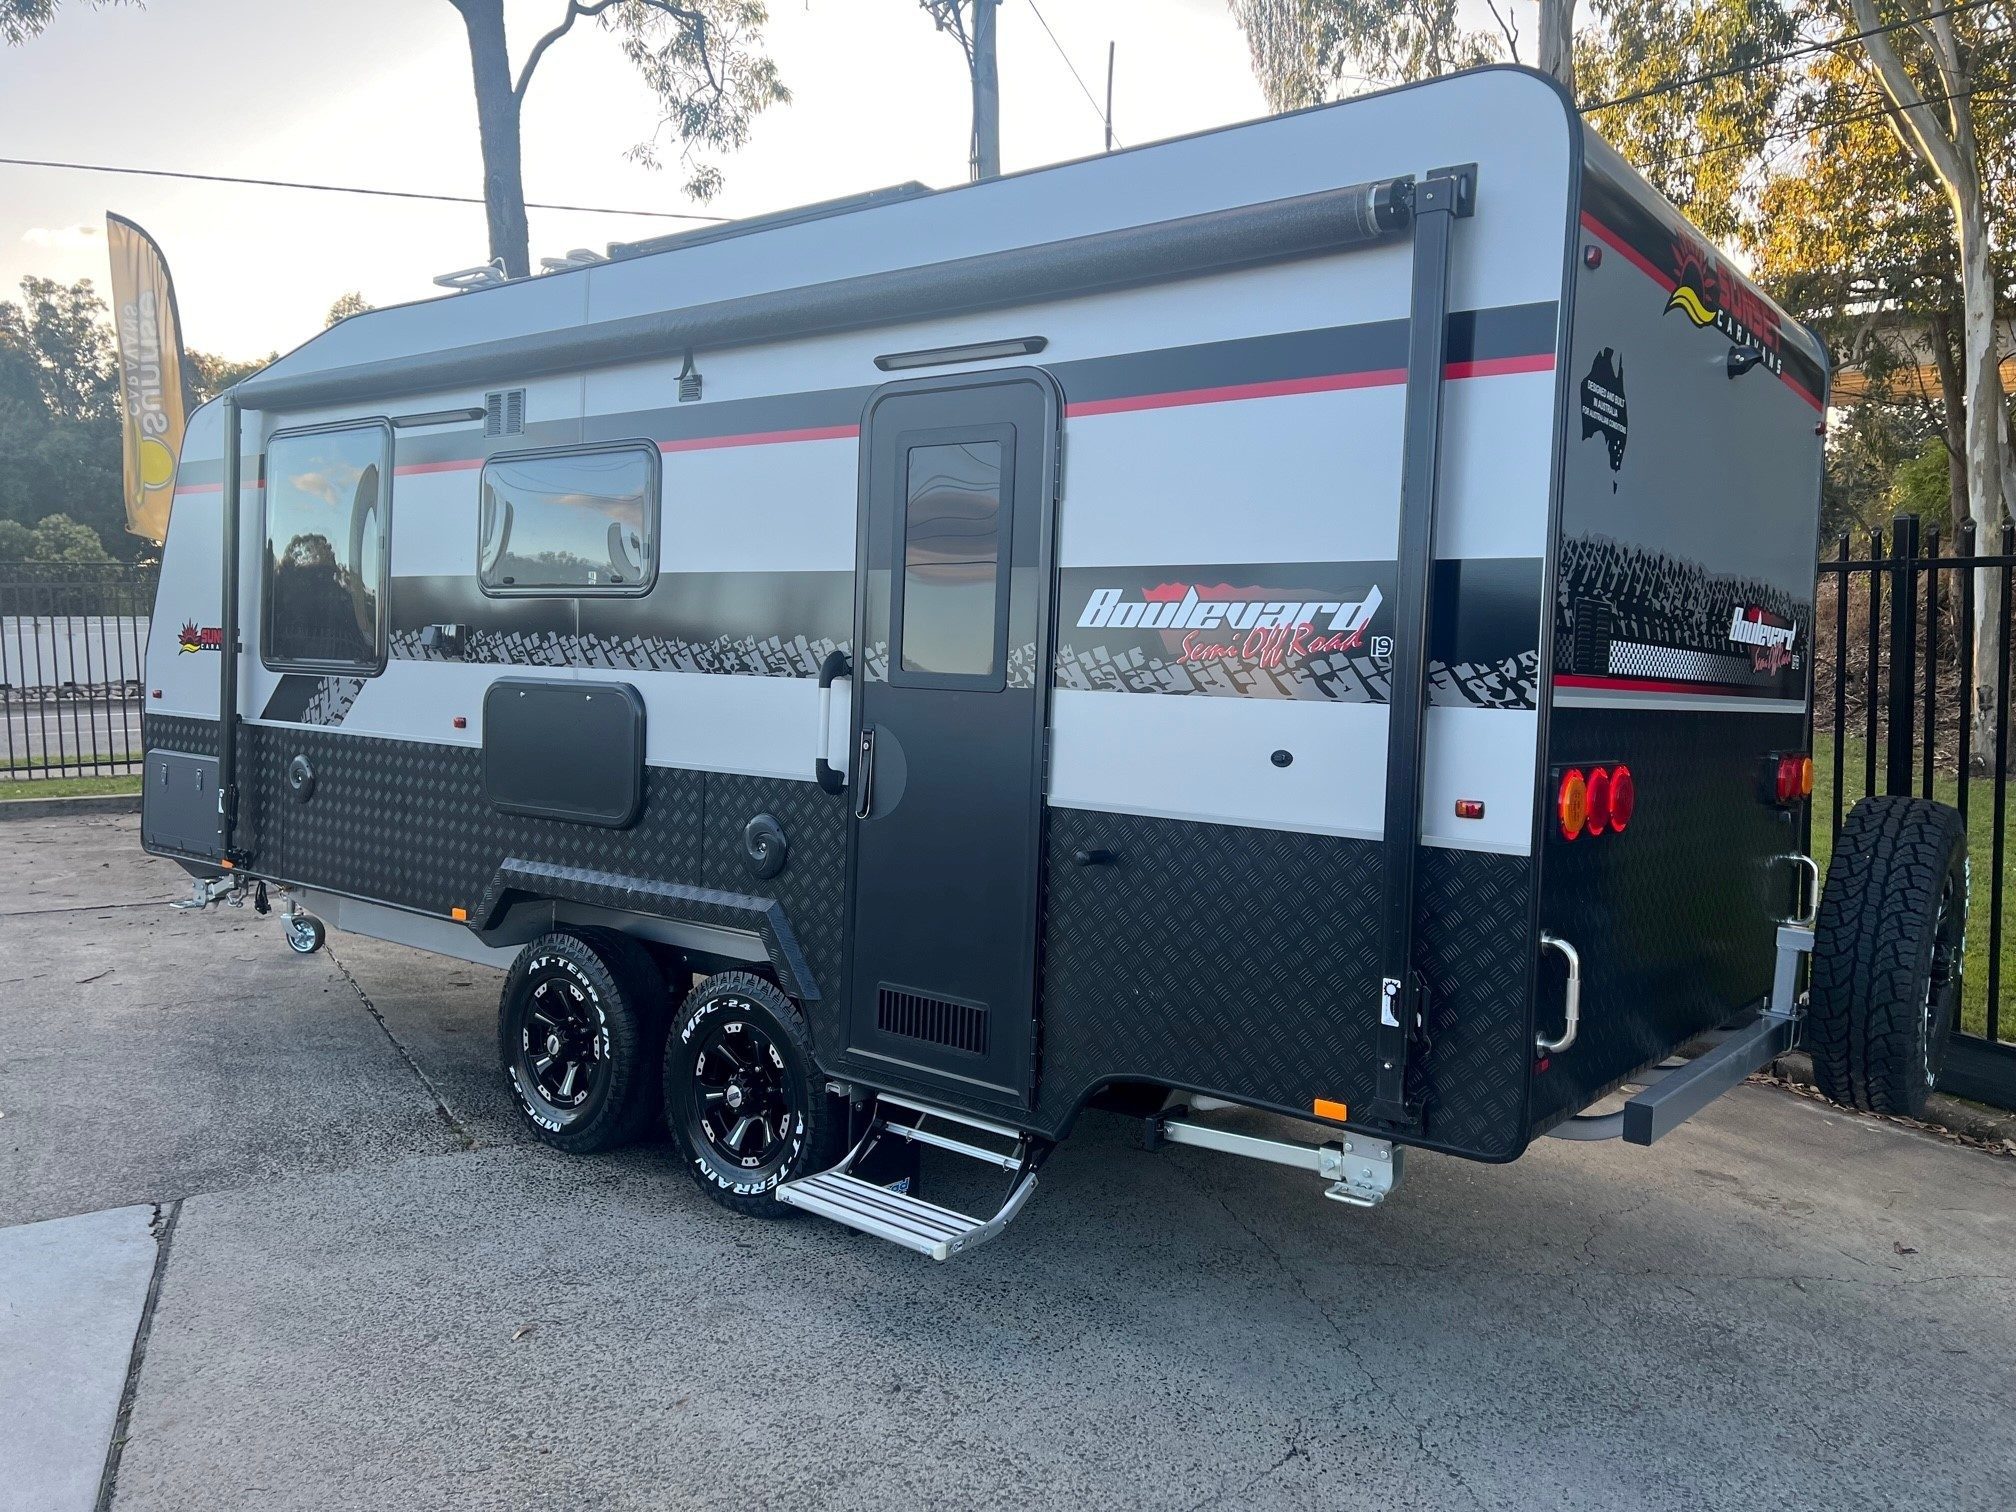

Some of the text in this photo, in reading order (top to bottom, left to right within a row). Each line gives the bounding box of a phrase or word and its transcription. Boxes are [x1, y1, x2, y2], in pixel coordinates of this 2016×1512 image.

[1582, 405, 1590, 415] FOR
[1587, 380, 1607, 398] DESIGNED
[1614, 395, 1625, 408] BUILT
[1598, 400, 1618, 417] AUSTRALIA
[1076, 584, 1385, 630] Boulevard
[1729, 606, 1797, 651] Boulevard
[201, 628, 224, 644] SUN
[1177, 617, 1371, 669] Semi Off Road
[528, 955, 611, 1060] AT-TERRAIN
[680, 997, 752, 1045] MPC-24
[695, 1110, 804, 1196] AT-TERRAIN
